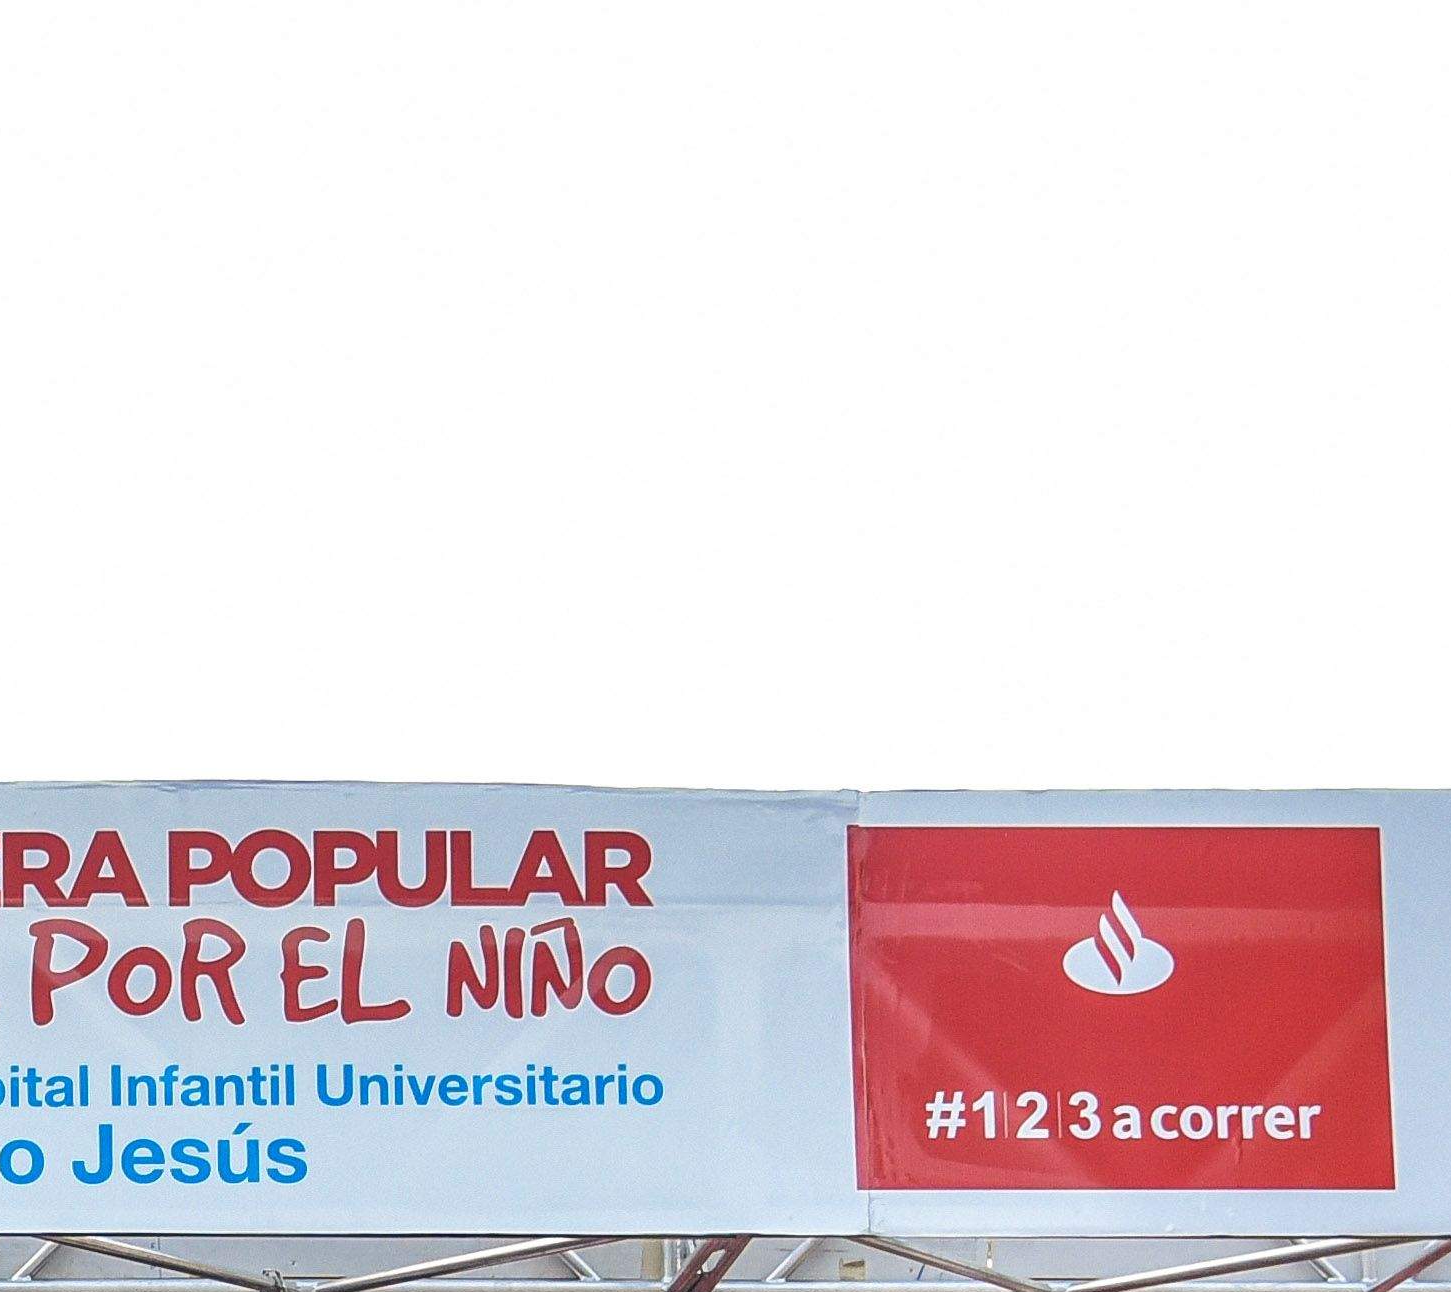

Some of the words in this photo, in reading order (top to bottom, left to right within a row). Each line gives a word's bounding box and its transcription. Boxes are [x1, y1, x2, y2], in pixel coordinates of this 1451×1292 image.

[167, 828, 653, 909] POPULAR
[30, 918, 246, 1029] POR
[280, 919, 412, 1025] EL
[445, 915, 652, 1017] NIÑO
[110, 1062, 296, 1107] Infantil
[314, 1061, 665, 1108] Universitario
[70, 1119, 308, 1186] Jesús
